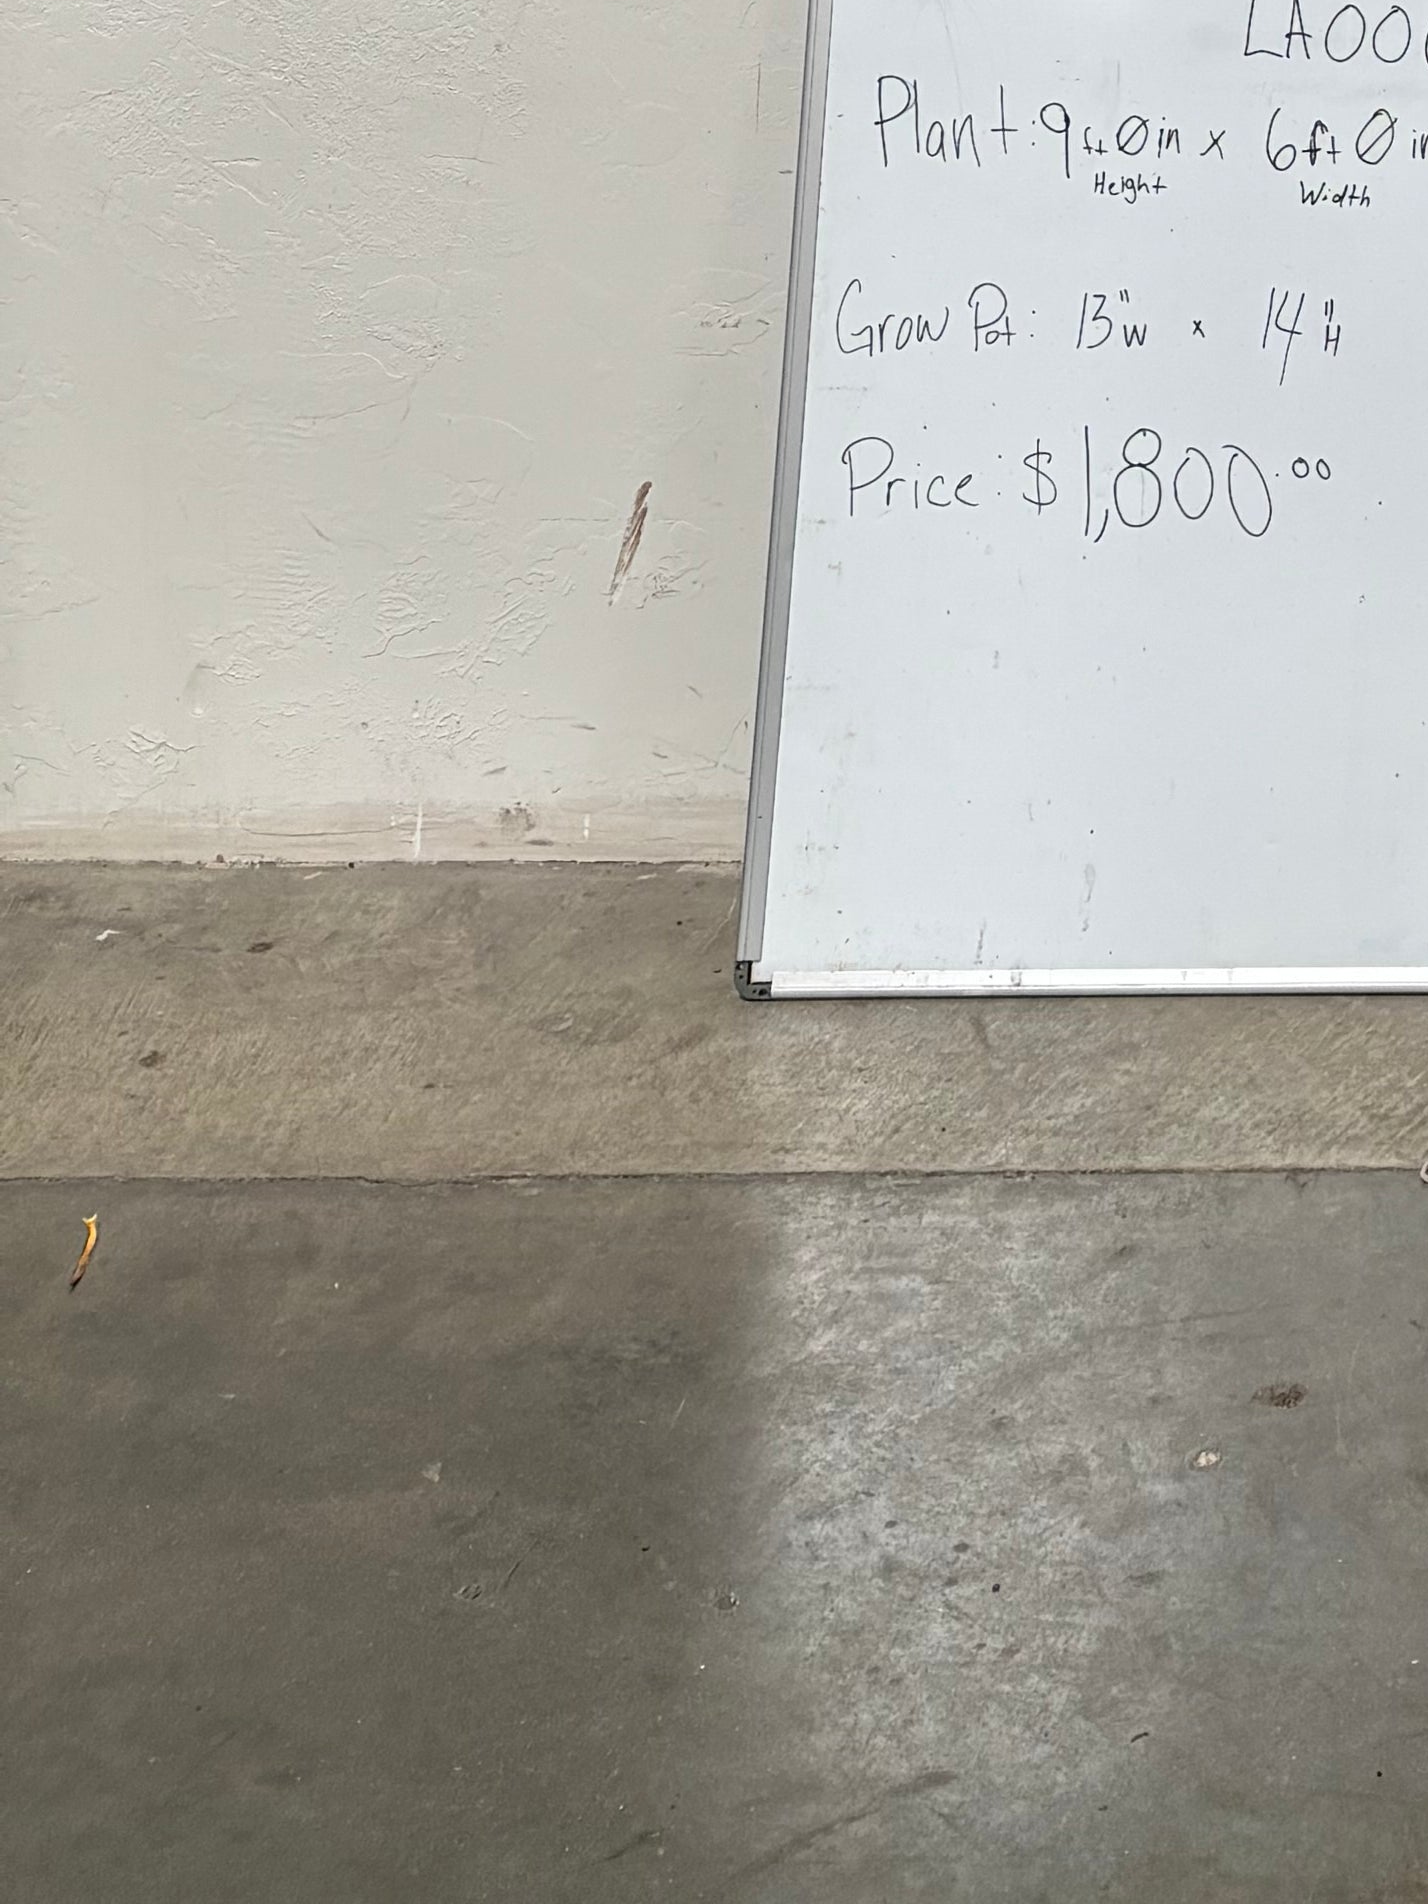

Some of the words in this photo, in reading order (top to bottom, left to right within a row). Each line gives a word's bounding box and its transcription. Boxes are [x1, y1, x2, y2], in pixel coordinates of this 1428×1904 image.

[1094, 172, 1168, 204] Height
[1301, 181, 1371, 208] Width
[836, 279, 949, 355] Grow
[968, 283, 1036, 352] Pot:
[842, 436, 1002, 516] Price:
